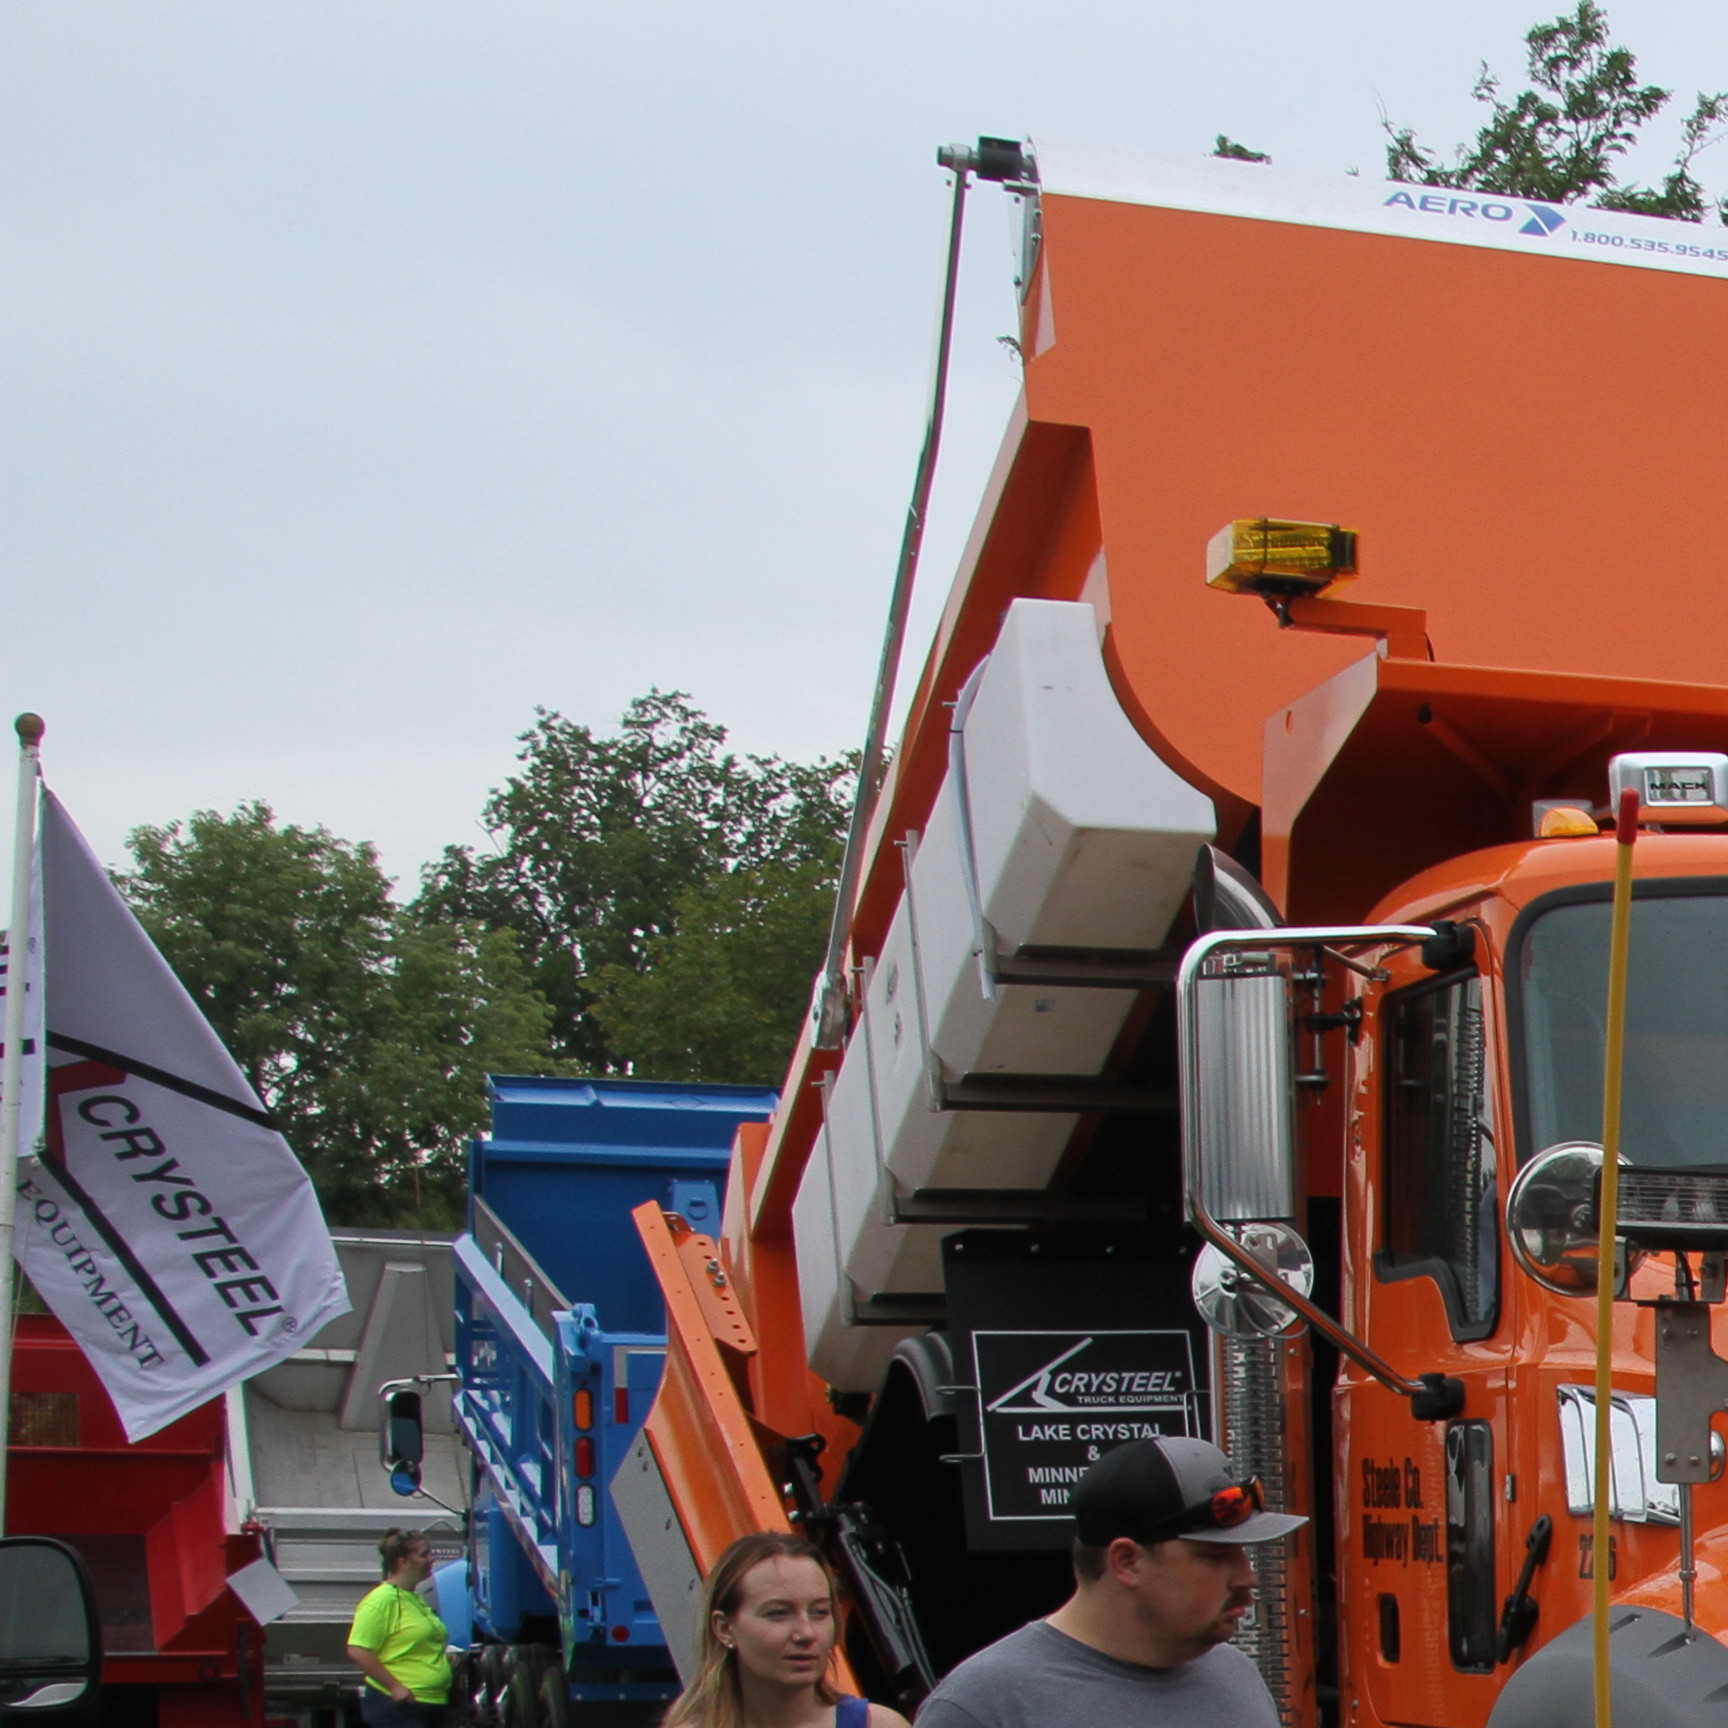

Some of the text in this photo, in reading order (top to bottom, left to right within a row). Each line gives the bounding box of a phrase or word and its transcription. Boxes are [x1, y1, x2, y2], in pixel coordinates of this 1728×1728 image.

[1382, 190, 1514, 222] AERO
[1650, 782, 1708, 790] MACK
[77, 1095, 286, 1337] CRYSTEEL
[16, 1178, 164, 1369] EQUIPMENT
[1054, 1372, 1176, 1393] CRYSTEEL
[1077, 1394, 1186, 1404] TRUCK EQUIPMENT
[1018, 1424, 1072, 1441] LAKE
[1088, 1445, 1101, 1461] &
